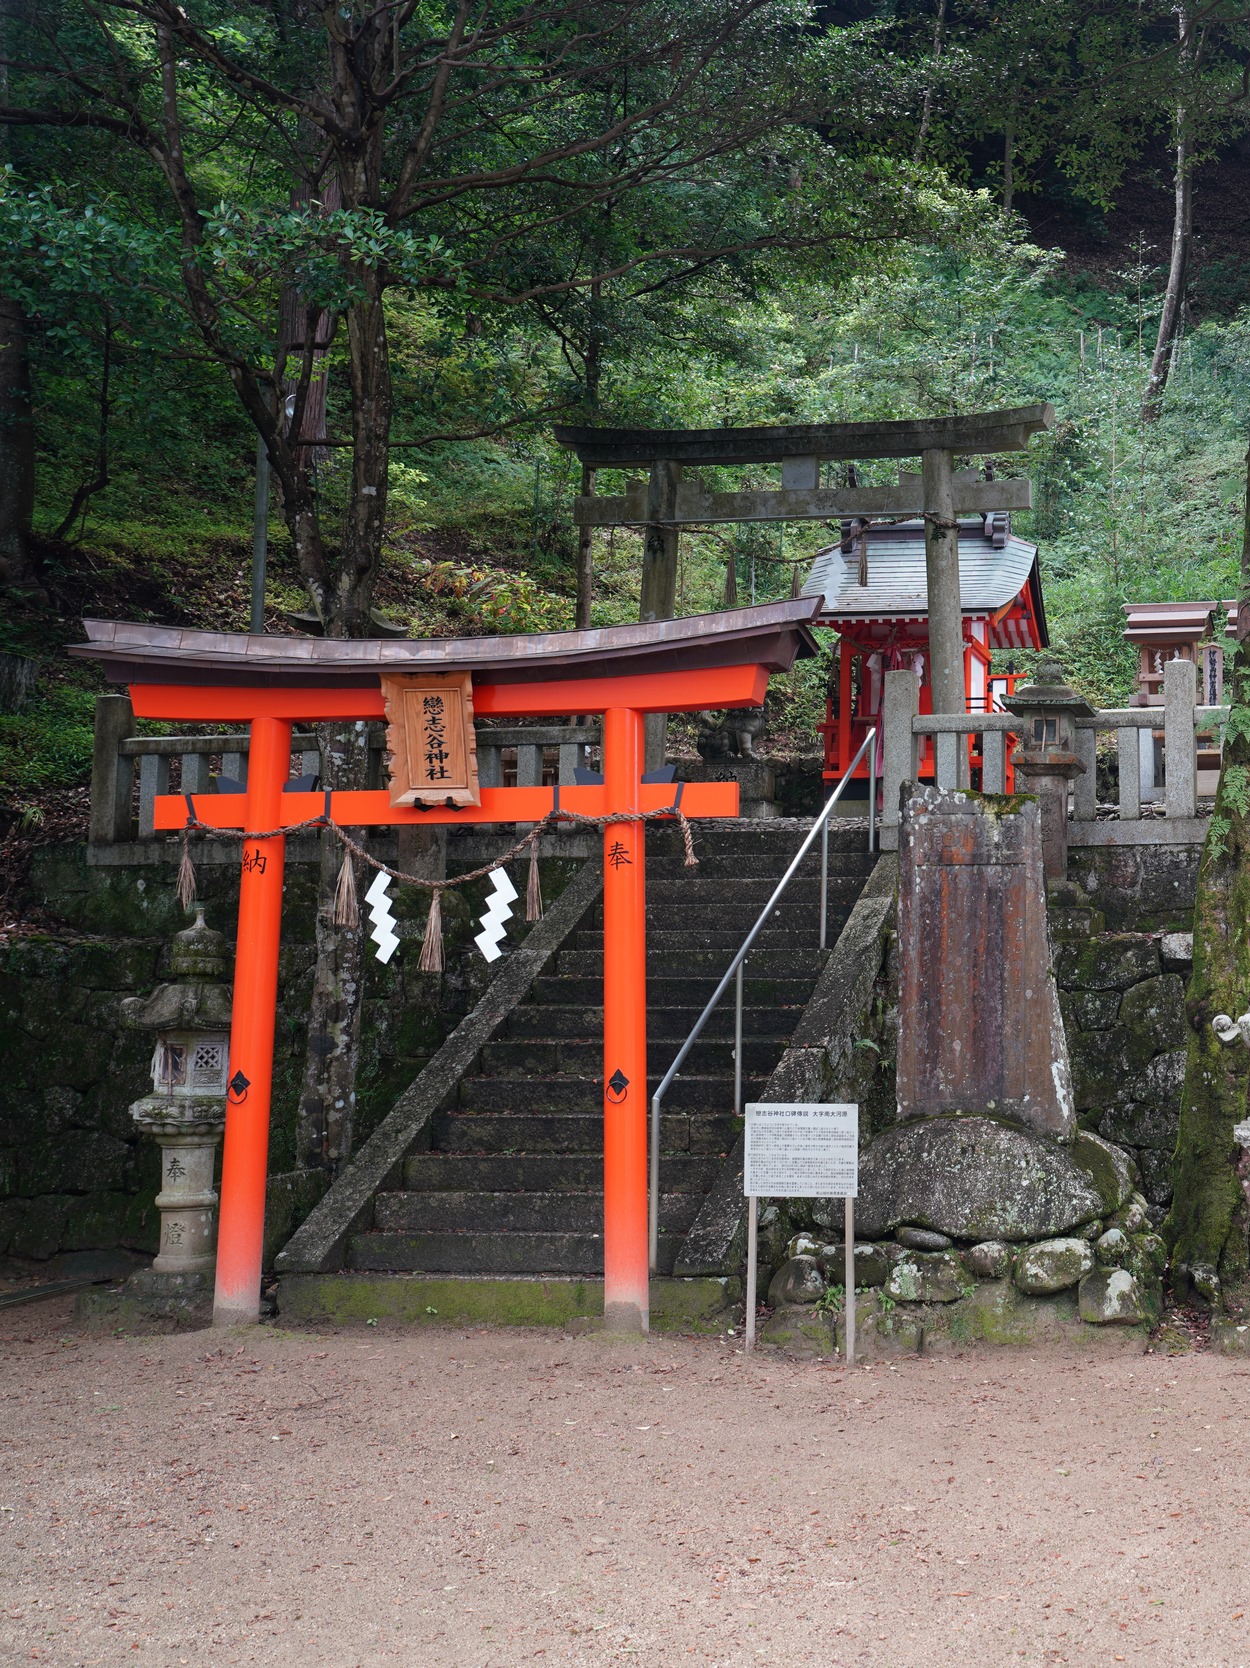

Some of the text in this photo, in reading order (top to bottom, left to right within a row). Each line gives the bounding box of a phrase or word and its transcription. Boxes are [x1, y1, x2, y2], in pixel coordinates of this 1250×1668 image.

[422, 695, 452, 781] 戀志谷神社
[242, 848, 268, 875] 納
[607, 840, 633, 871] 奉
[166, 1157, 187, 1184] 奉
